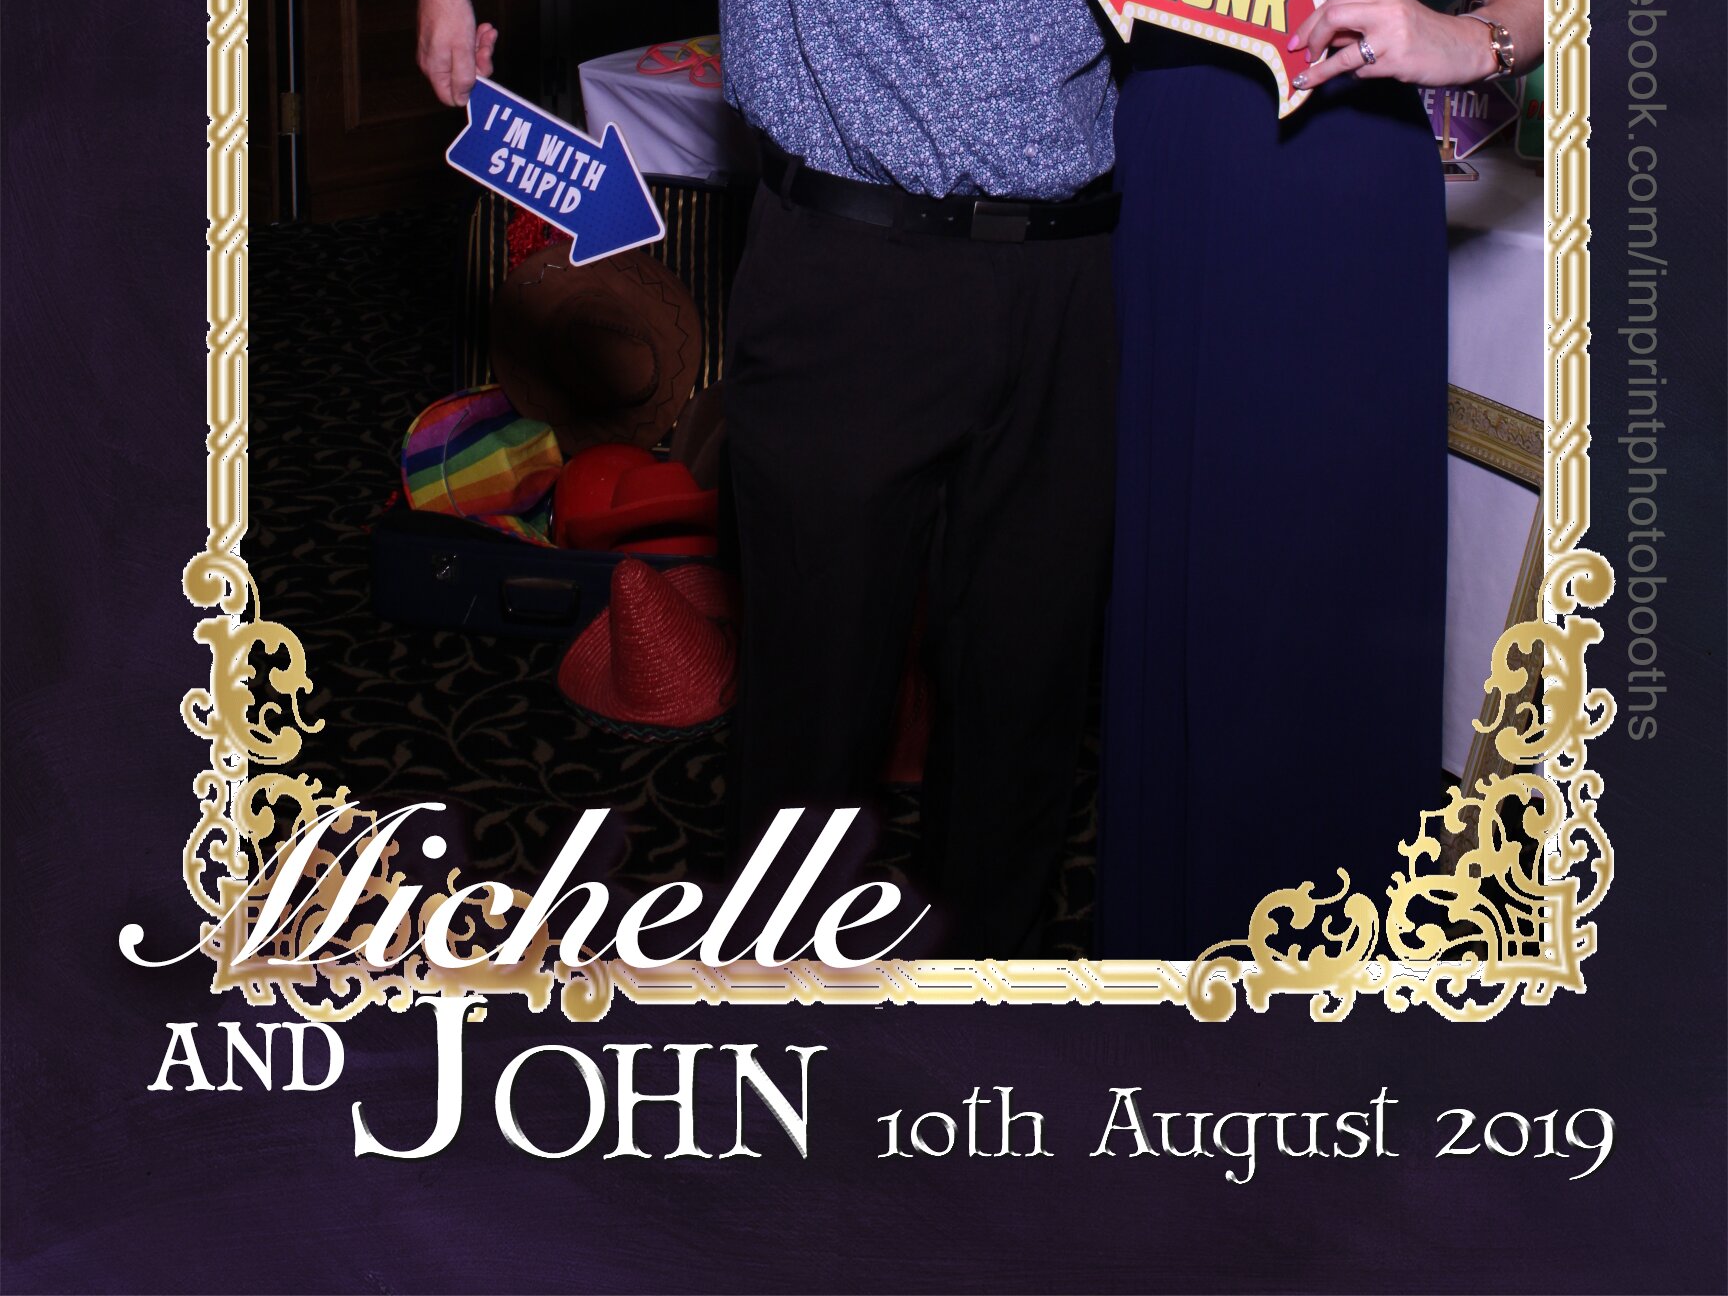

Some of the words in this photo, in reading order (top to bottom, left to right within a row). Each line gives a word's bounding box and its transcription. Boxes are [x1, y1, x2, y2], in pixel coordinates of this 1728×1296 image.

[1444, 89, 1489, 120] HIM
[483, 104, 532, 150] I'M
[536, 133, 607, 191] WITH
[488, 147, 582, 214] STUPID
